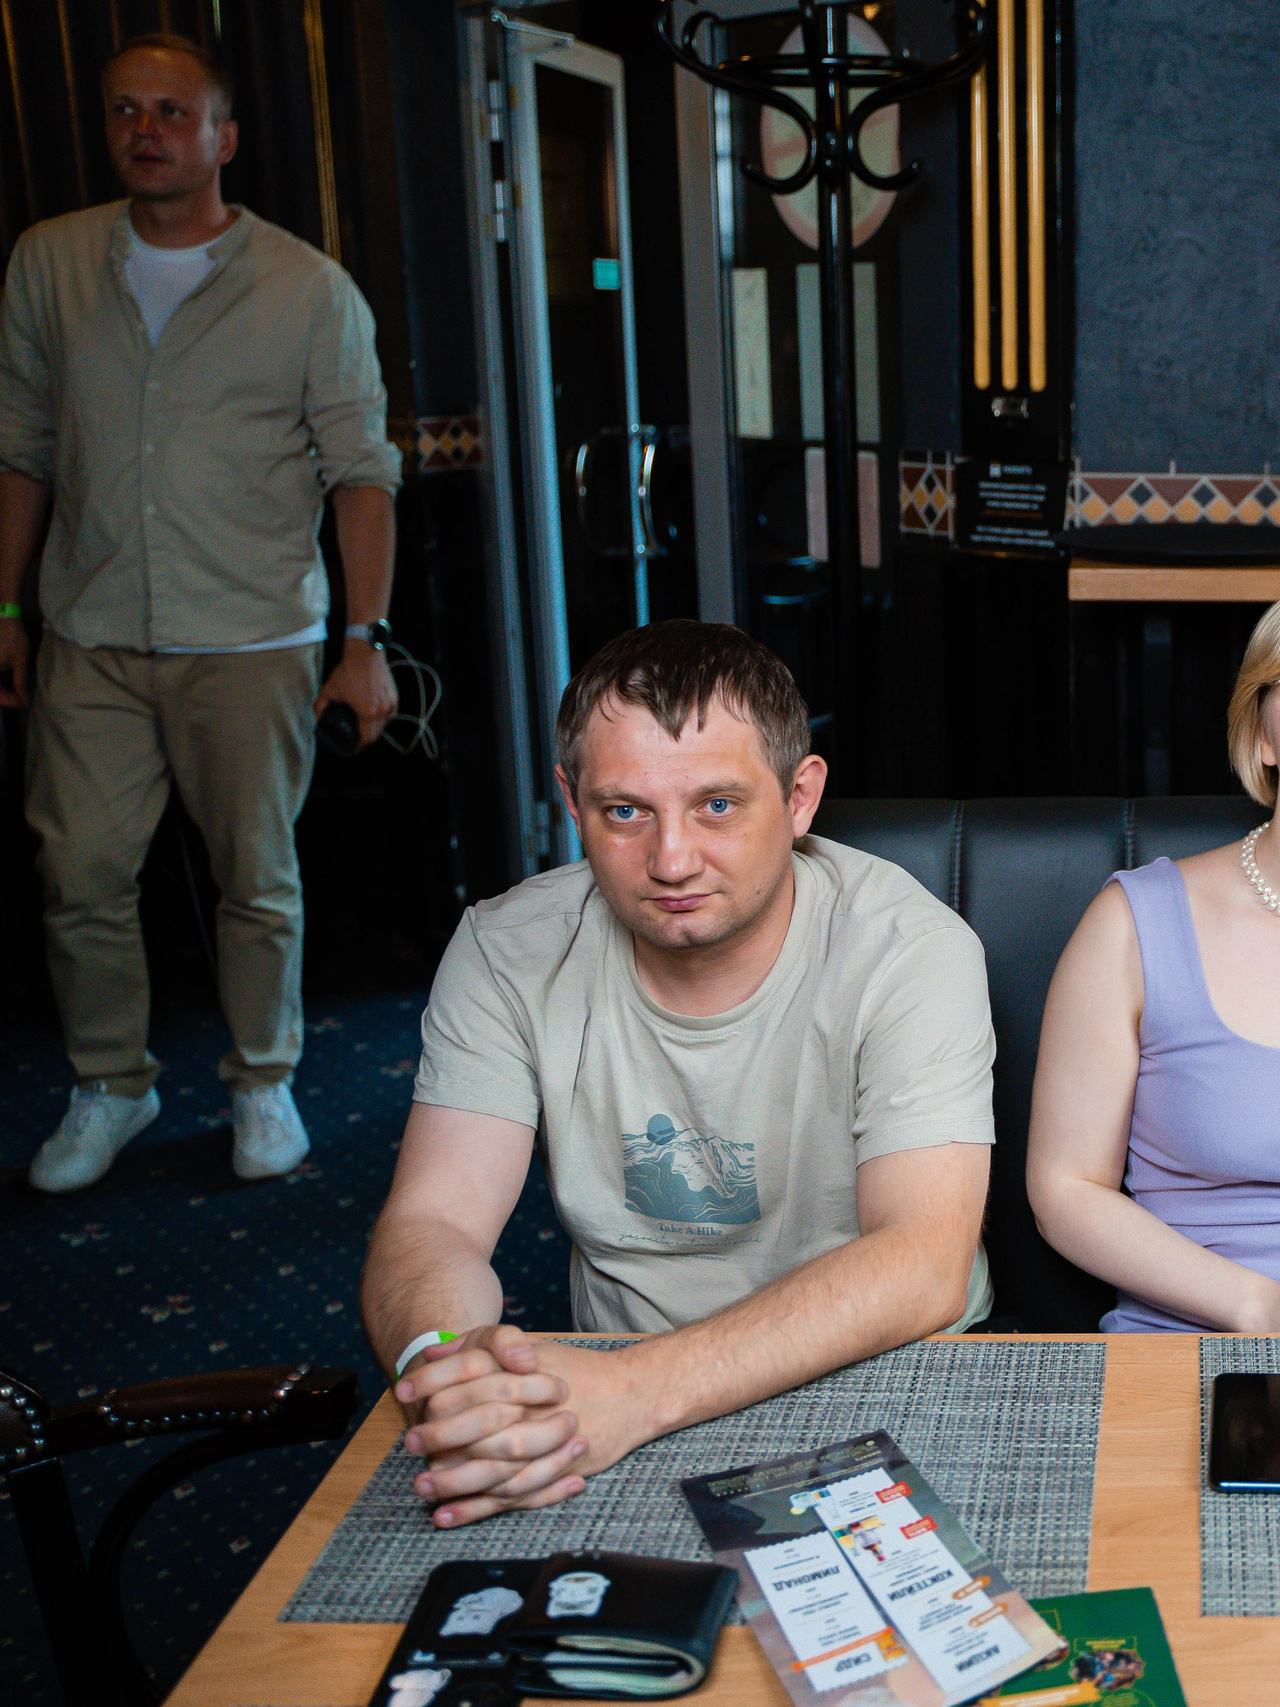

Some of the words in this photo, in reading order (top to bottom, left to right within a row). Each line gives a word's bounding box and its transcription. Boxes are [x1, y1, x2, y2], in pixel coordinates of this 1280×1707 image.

[658, 1222, 683, 1234] Take
[686, 1226, 694, 1236] A
[697, 1226, 723, 1237] Hike
[771, 1565, 840, 1592] ЛИМОНАД
[887, 1569, 954, 1601] КОКТЕЙЛИ
[835, 1652, 872, 1673] СИДР
[955, 1644, 1000, 1673] АКЦИИ
